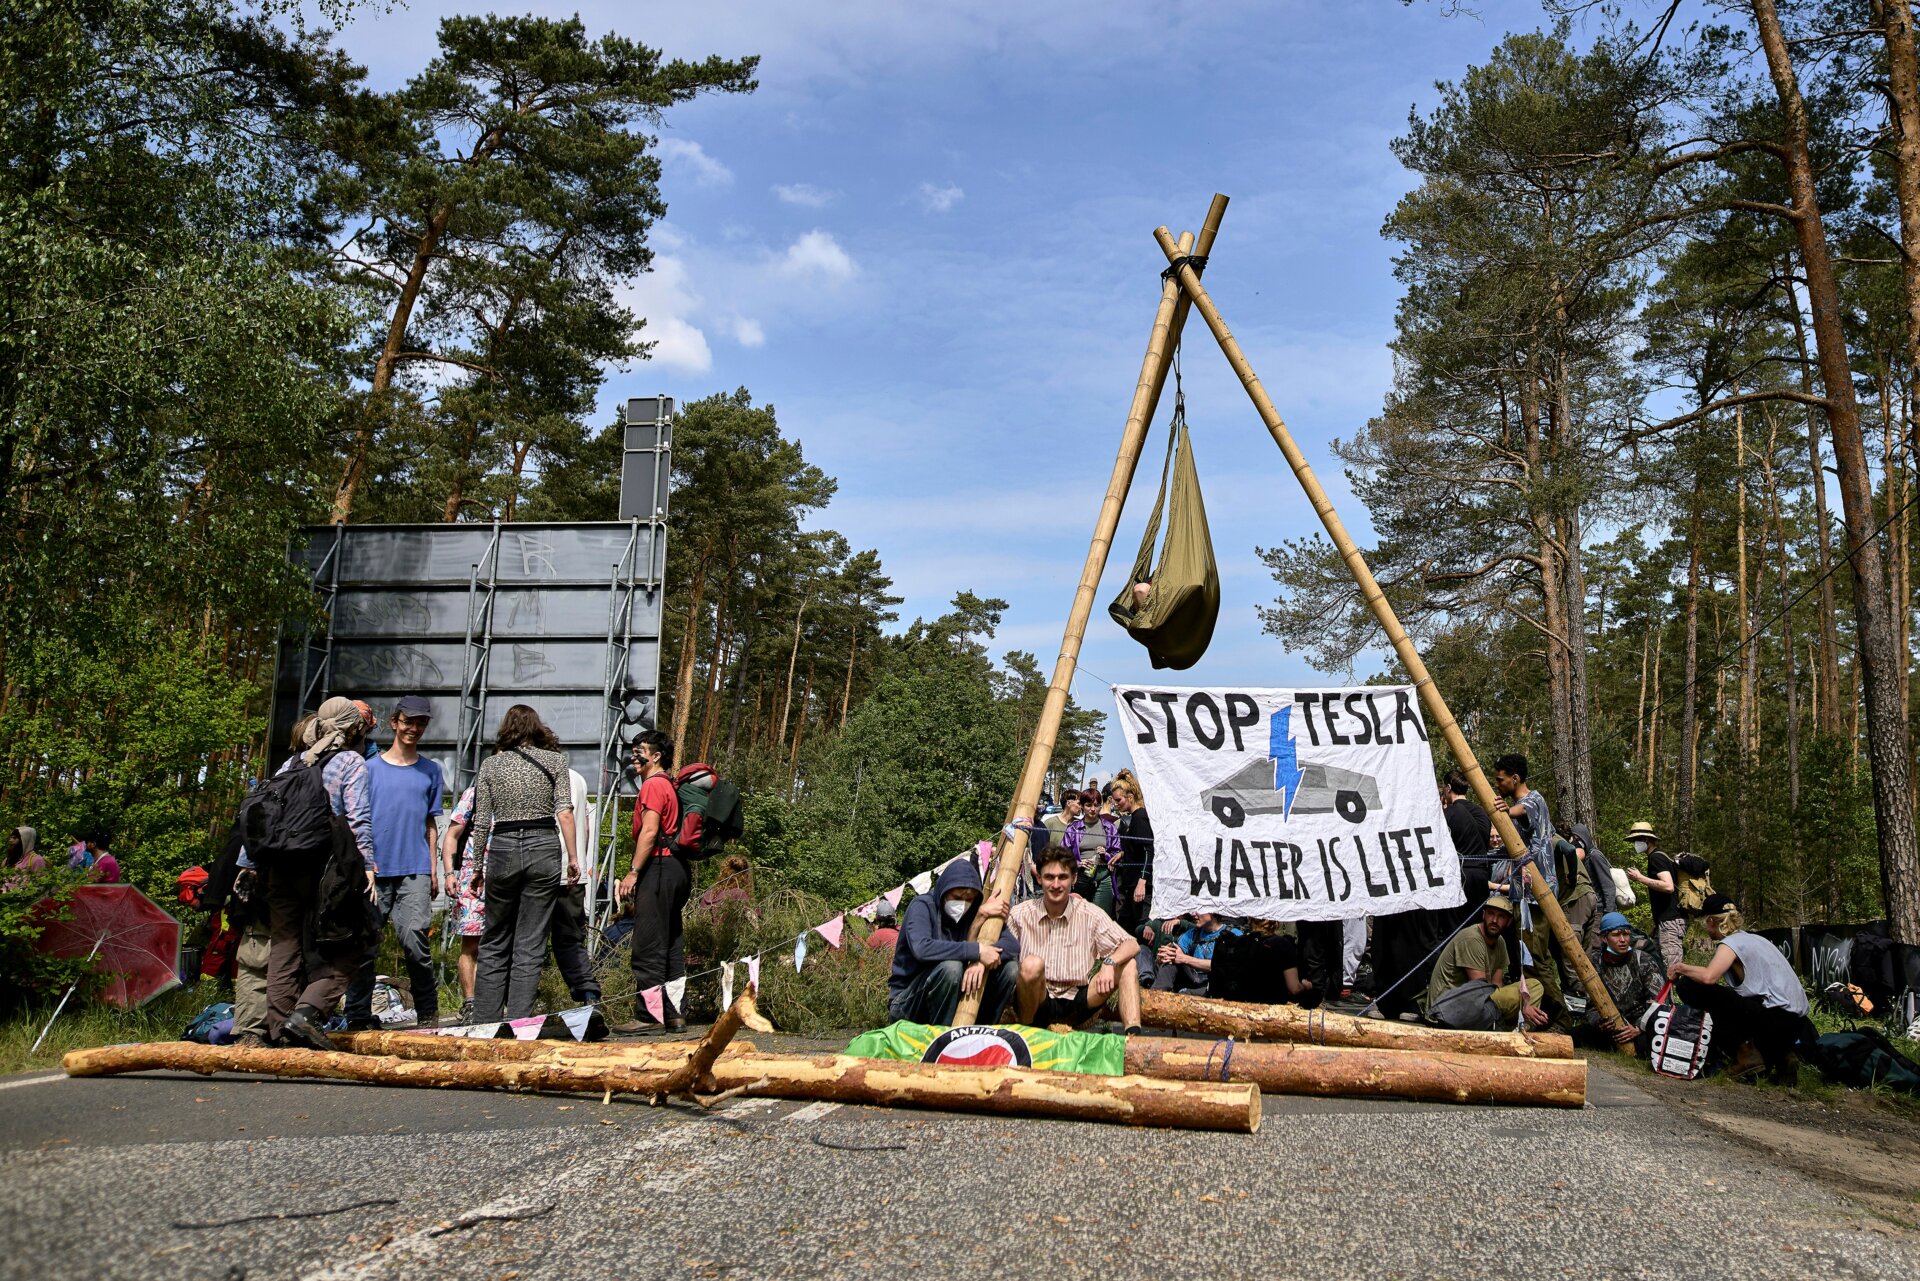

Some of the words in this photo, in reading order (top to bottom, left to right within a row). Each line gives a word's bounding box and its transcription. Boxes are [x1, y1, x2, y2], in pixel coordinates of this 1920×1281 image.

[1122, 691, 1259, 751] STOP
[1295, 692, 1429, 746] TESLA
[1179, 835, 1310, 900] WATER
[1316, 836, 1351, 902] IS
[1354, 826, 1445, 898] LIFE
